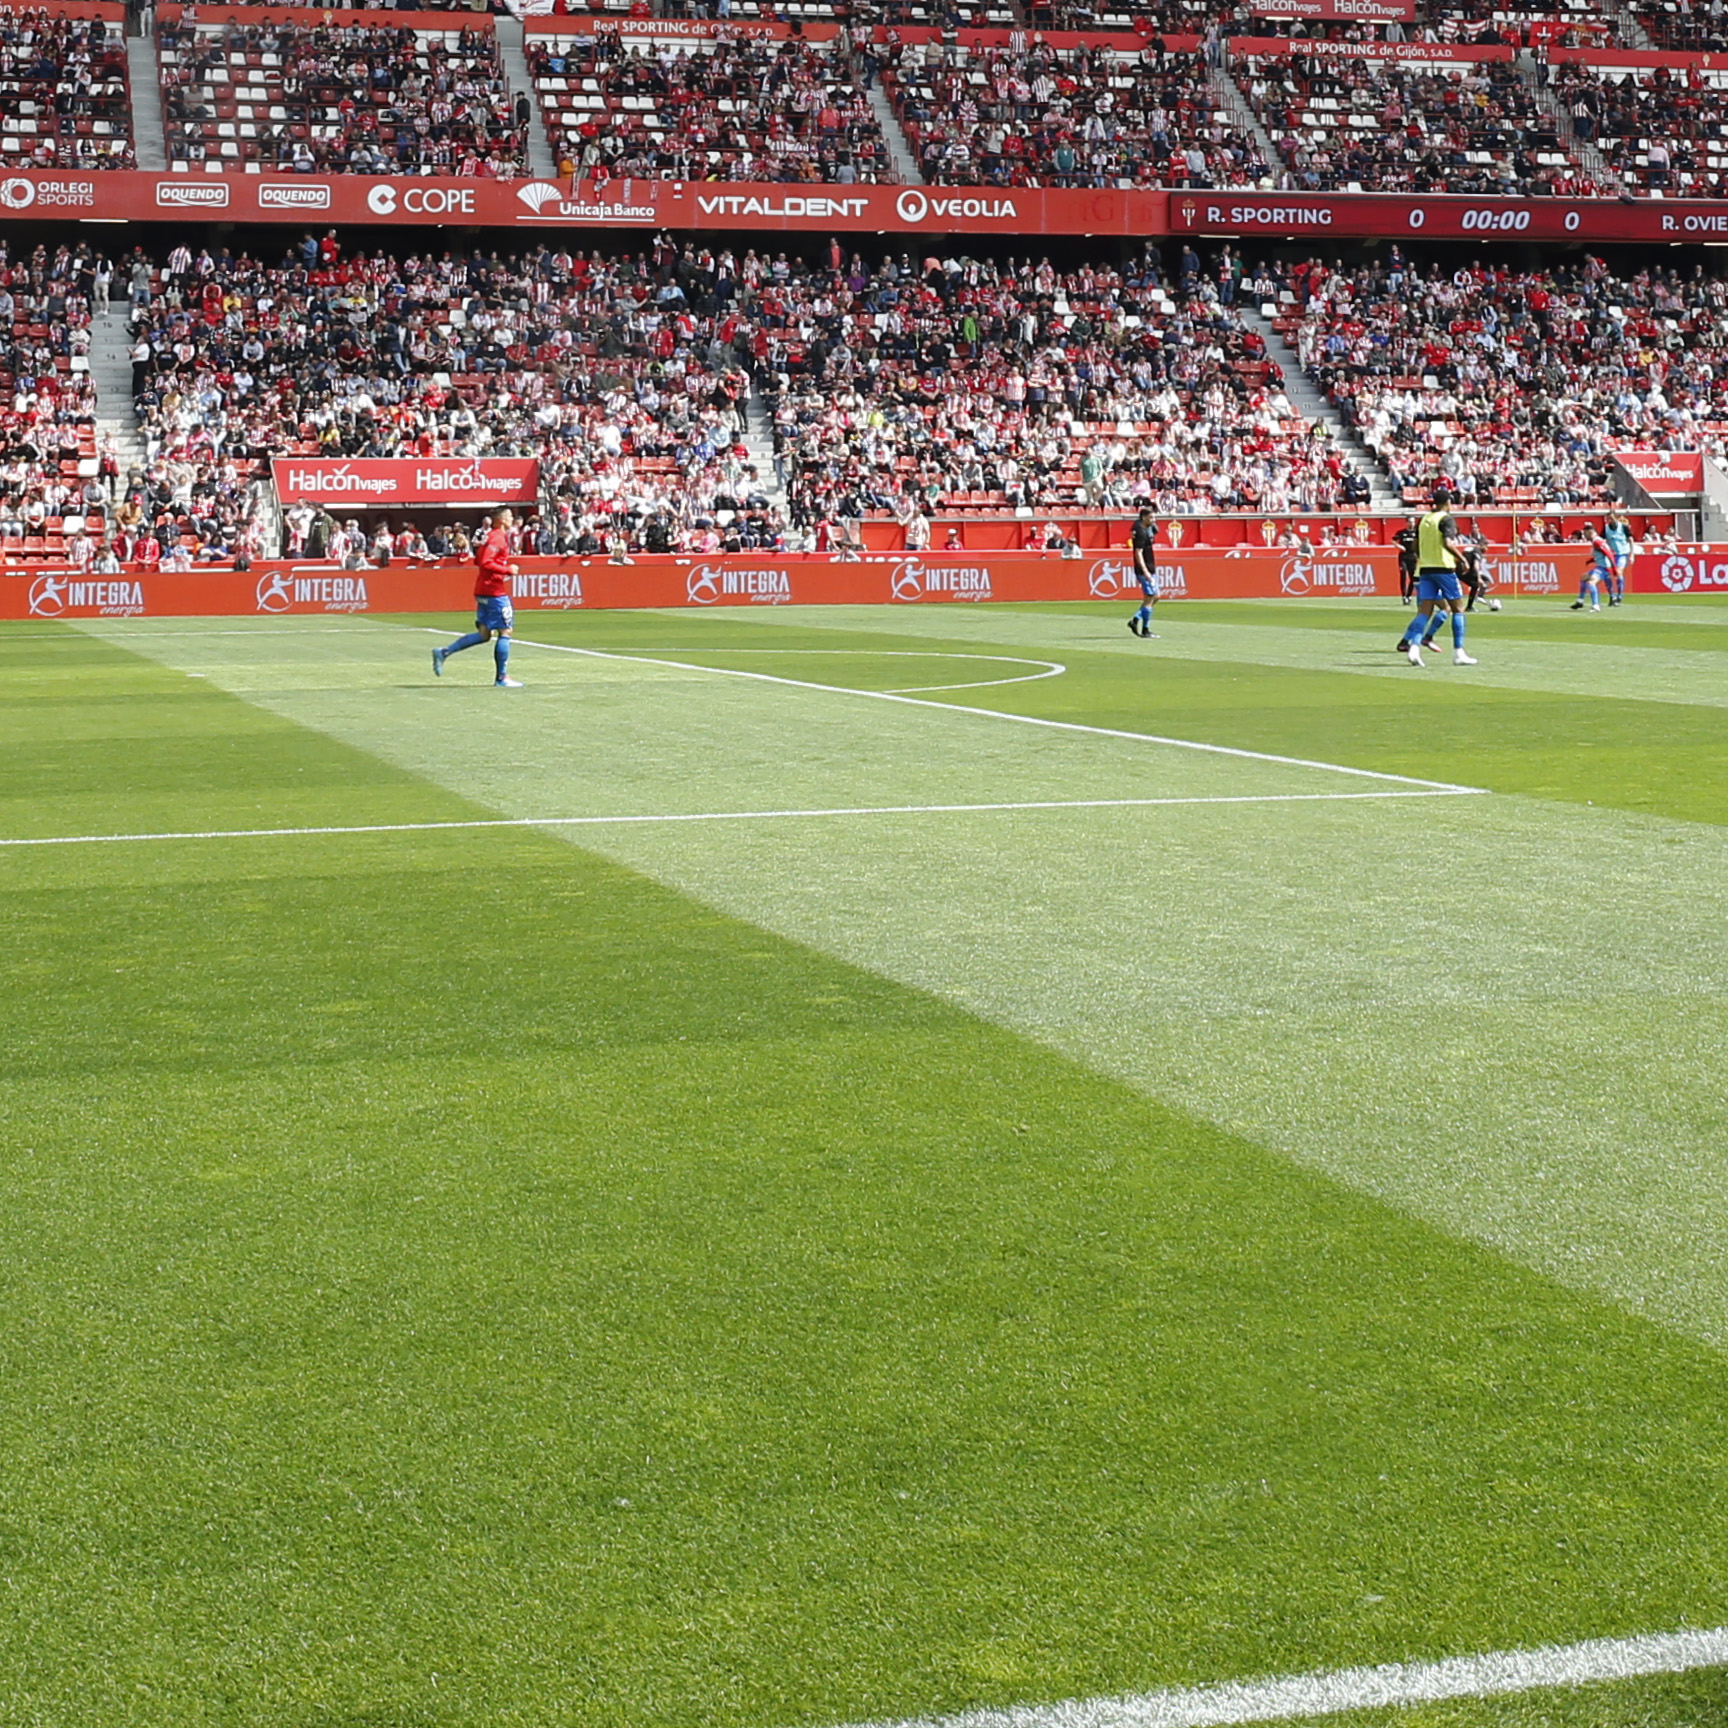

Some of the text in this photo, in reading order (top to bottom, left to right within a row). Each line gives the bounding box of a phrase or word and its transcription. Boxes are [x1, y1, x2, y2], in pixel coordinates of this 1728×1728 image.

[593, 20, 618, 32] Real
[622, 20, 690, 34] SPORTING
[692, 21, 707, 34] de
[1315, 43, 1376, 56] SPORTING
[1379, 44, 1394, 56] de
[38, 181, 93, 194] ORLEGI
[160, 187, 225, 206] OQUENDO
[37, 193, 94, 207] SPORTS
[263, 189, 327, 208] OQUENDO
[404, 187, 475, 214] COPE
[698, 195, 868, 217] VITALDENT
[931, 198, 1017, 218] VEOLIA
[559, 200, 655, 219] Unicaja Banco
[1207, 207, 1226, 223] R.
[1231, 207, 1332, 225] SPORTING
[1409, 209, 1424, 228] 0
[1462, 210, 1530, 231] 00:00
[1564, 211, 1580, 231] 0
[1662, 215, 1680, 231] R.
[723, 570, 789, 594] INTEGRA
[925, 568, 991, 591] INTEGRA
[1122, 566, 1186, 587] INGRA
[1313, 565, 1375, 586] INTEGRA
[1498, 562, 1558, 583] INTEGRA
[68, 581, 143, 606] INTEGRA
[294, 577, 366, 602] INTEGRA
[512, 574, 582, 597] INTEGRA
